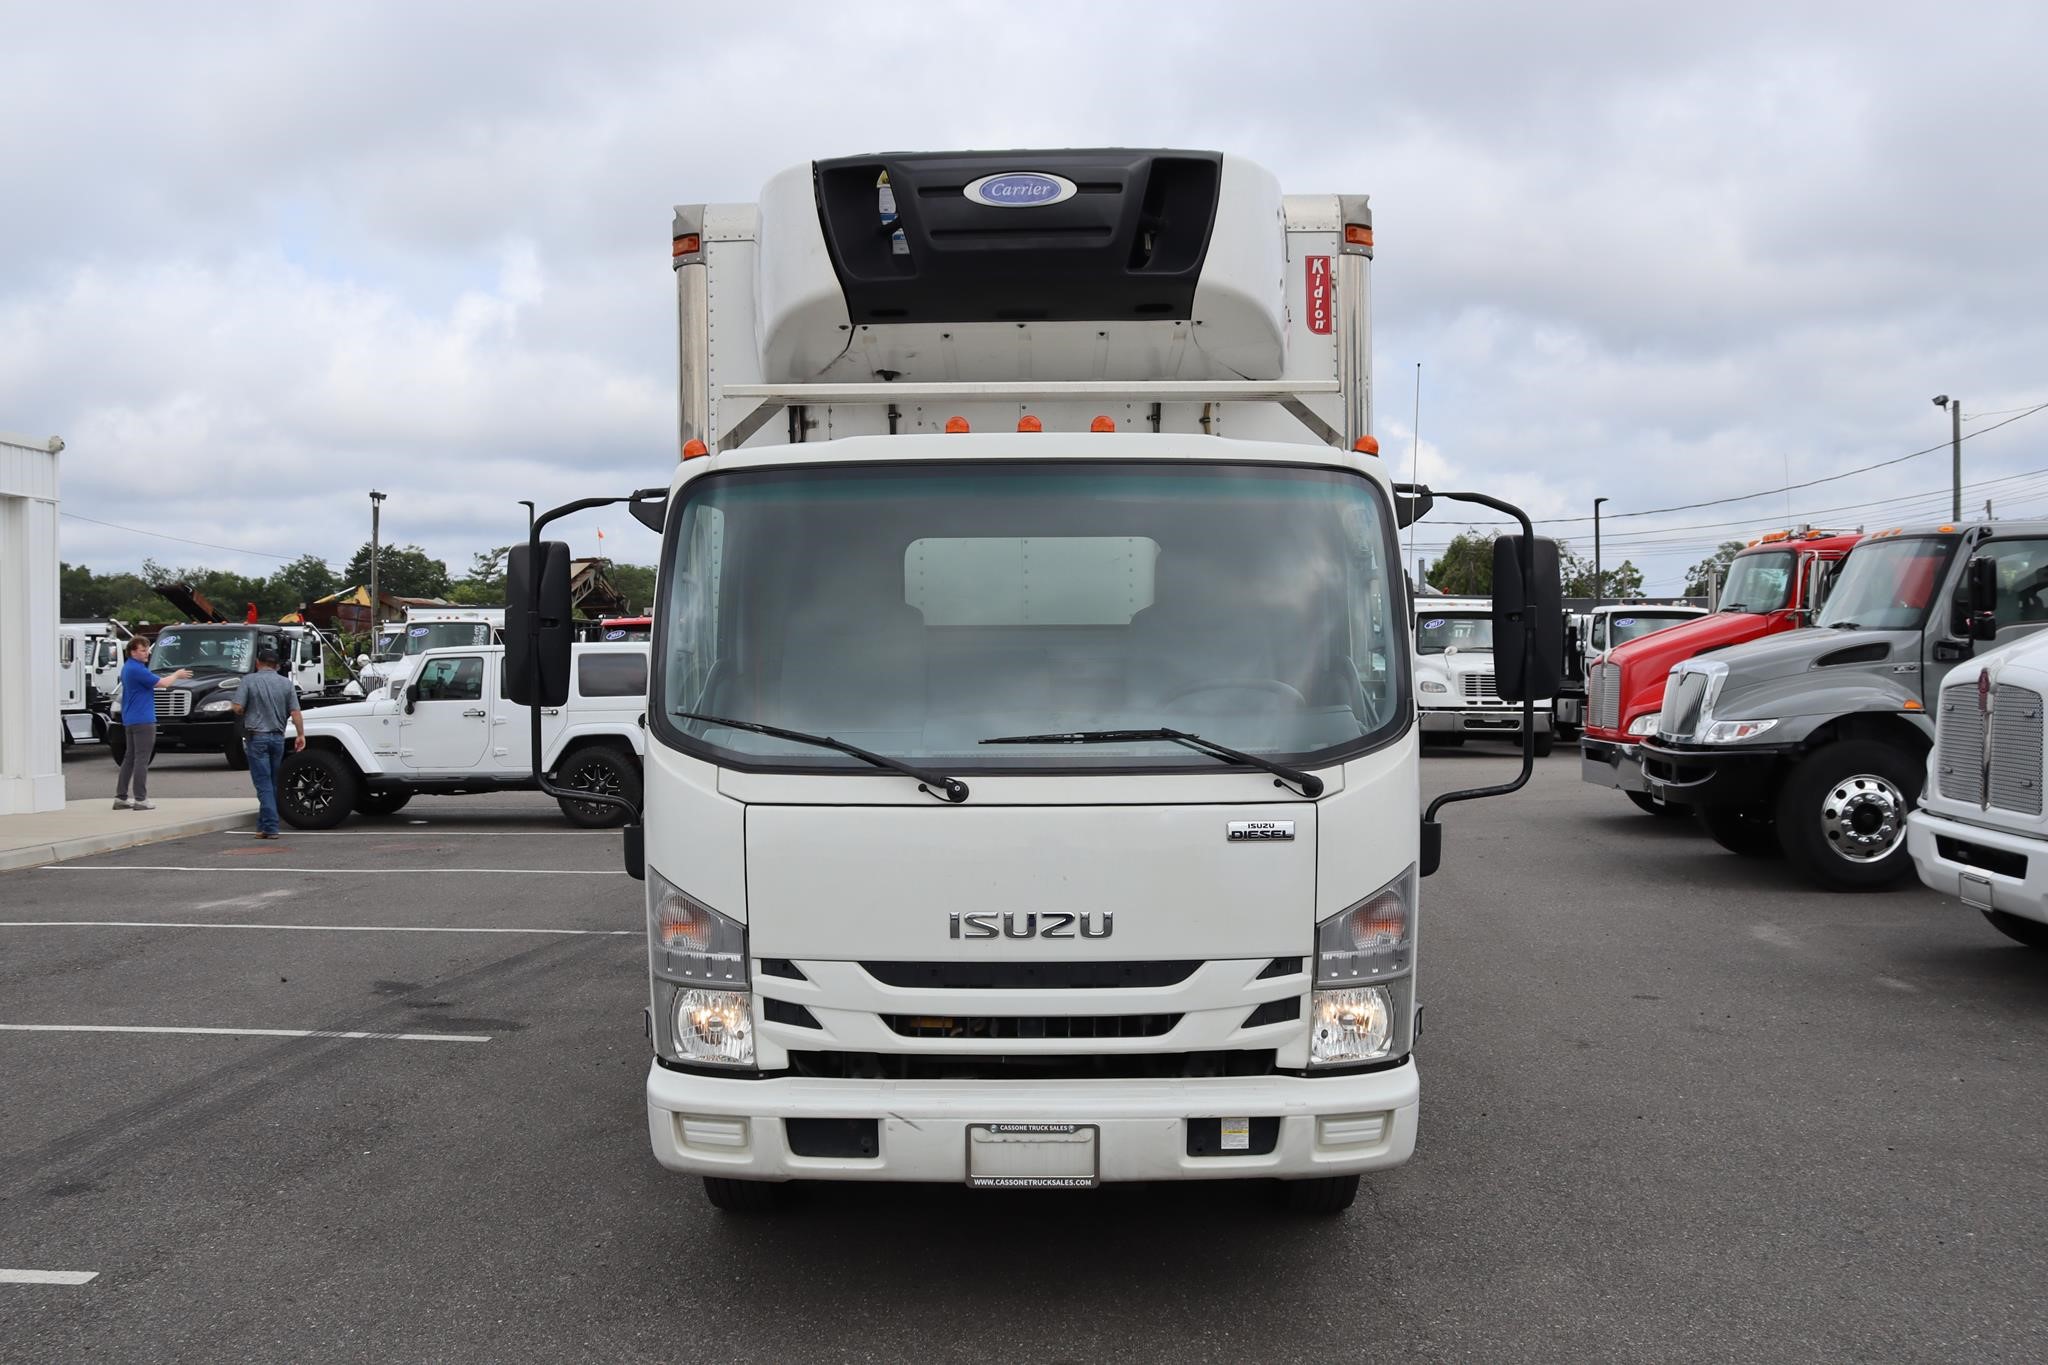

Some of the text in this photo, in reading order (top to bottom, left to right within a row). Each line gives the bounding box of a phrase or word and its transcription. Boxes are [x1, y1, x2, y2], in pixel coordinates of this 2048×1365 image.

[991, 183, 1050, 197] Carrier
[1311, 258, 1325, 330] Kidron
[1231, 830, 1293, 839] DIESEL
[949, 911, 1114, 939] ISUZU
[974, 1178, 1092, 1187] WWW.CASSONETRUCKSALES.COM
